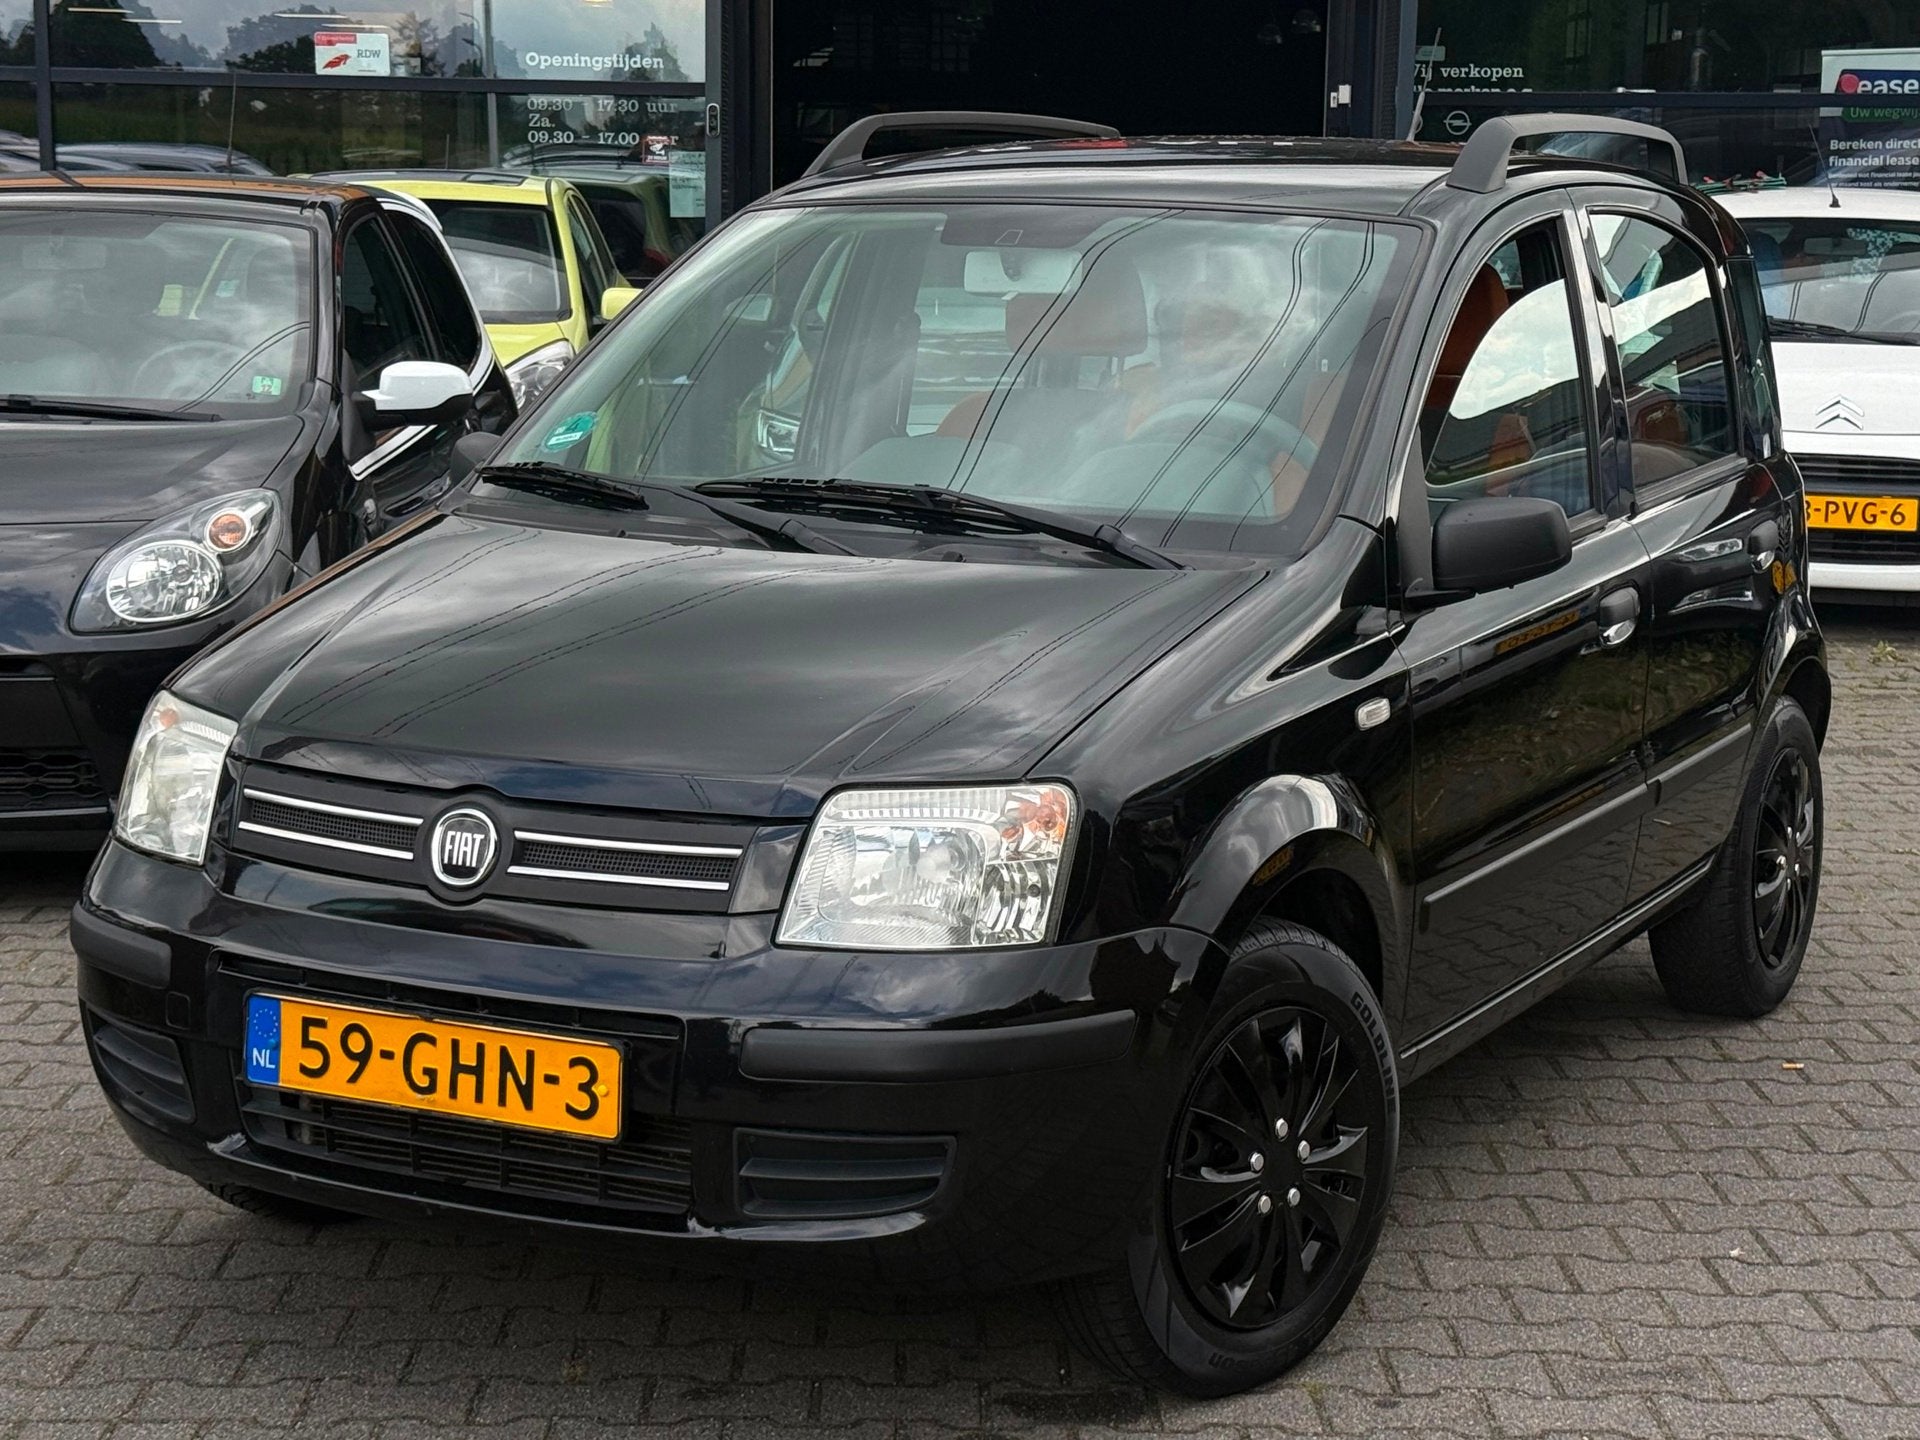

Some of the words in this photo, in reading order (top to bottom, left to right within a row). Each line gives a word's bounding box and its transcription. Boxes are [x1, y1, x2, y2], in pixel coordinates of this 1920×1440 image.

[357, 49, 381, 59] RDW
[525, 52, 664, 71] Openingstijden
[1440, 63, 1524, 82] verkopen
[527, 98, 573, 111] 09.30
[646, 101, 678, 113] uur
[528, 113, 556, 127] Za.
[1873, 107, 1920, 120] wegwij
[527, 130, 574, 144] 09.30
[598, 131, 640, 145] 17.00
[1830, 139, 1883, 150] Bereken
[1828, 155, 1884, 167] financial
[1886, 154, 1920, 166] lease
[443, 830, 485, 868] FIAT
[252, 1047, 276, 1070] NL
[1350, 991, 1397, 1115] GOLDLINE
[299, 1015, 600, 1121] 59-GHN-3
